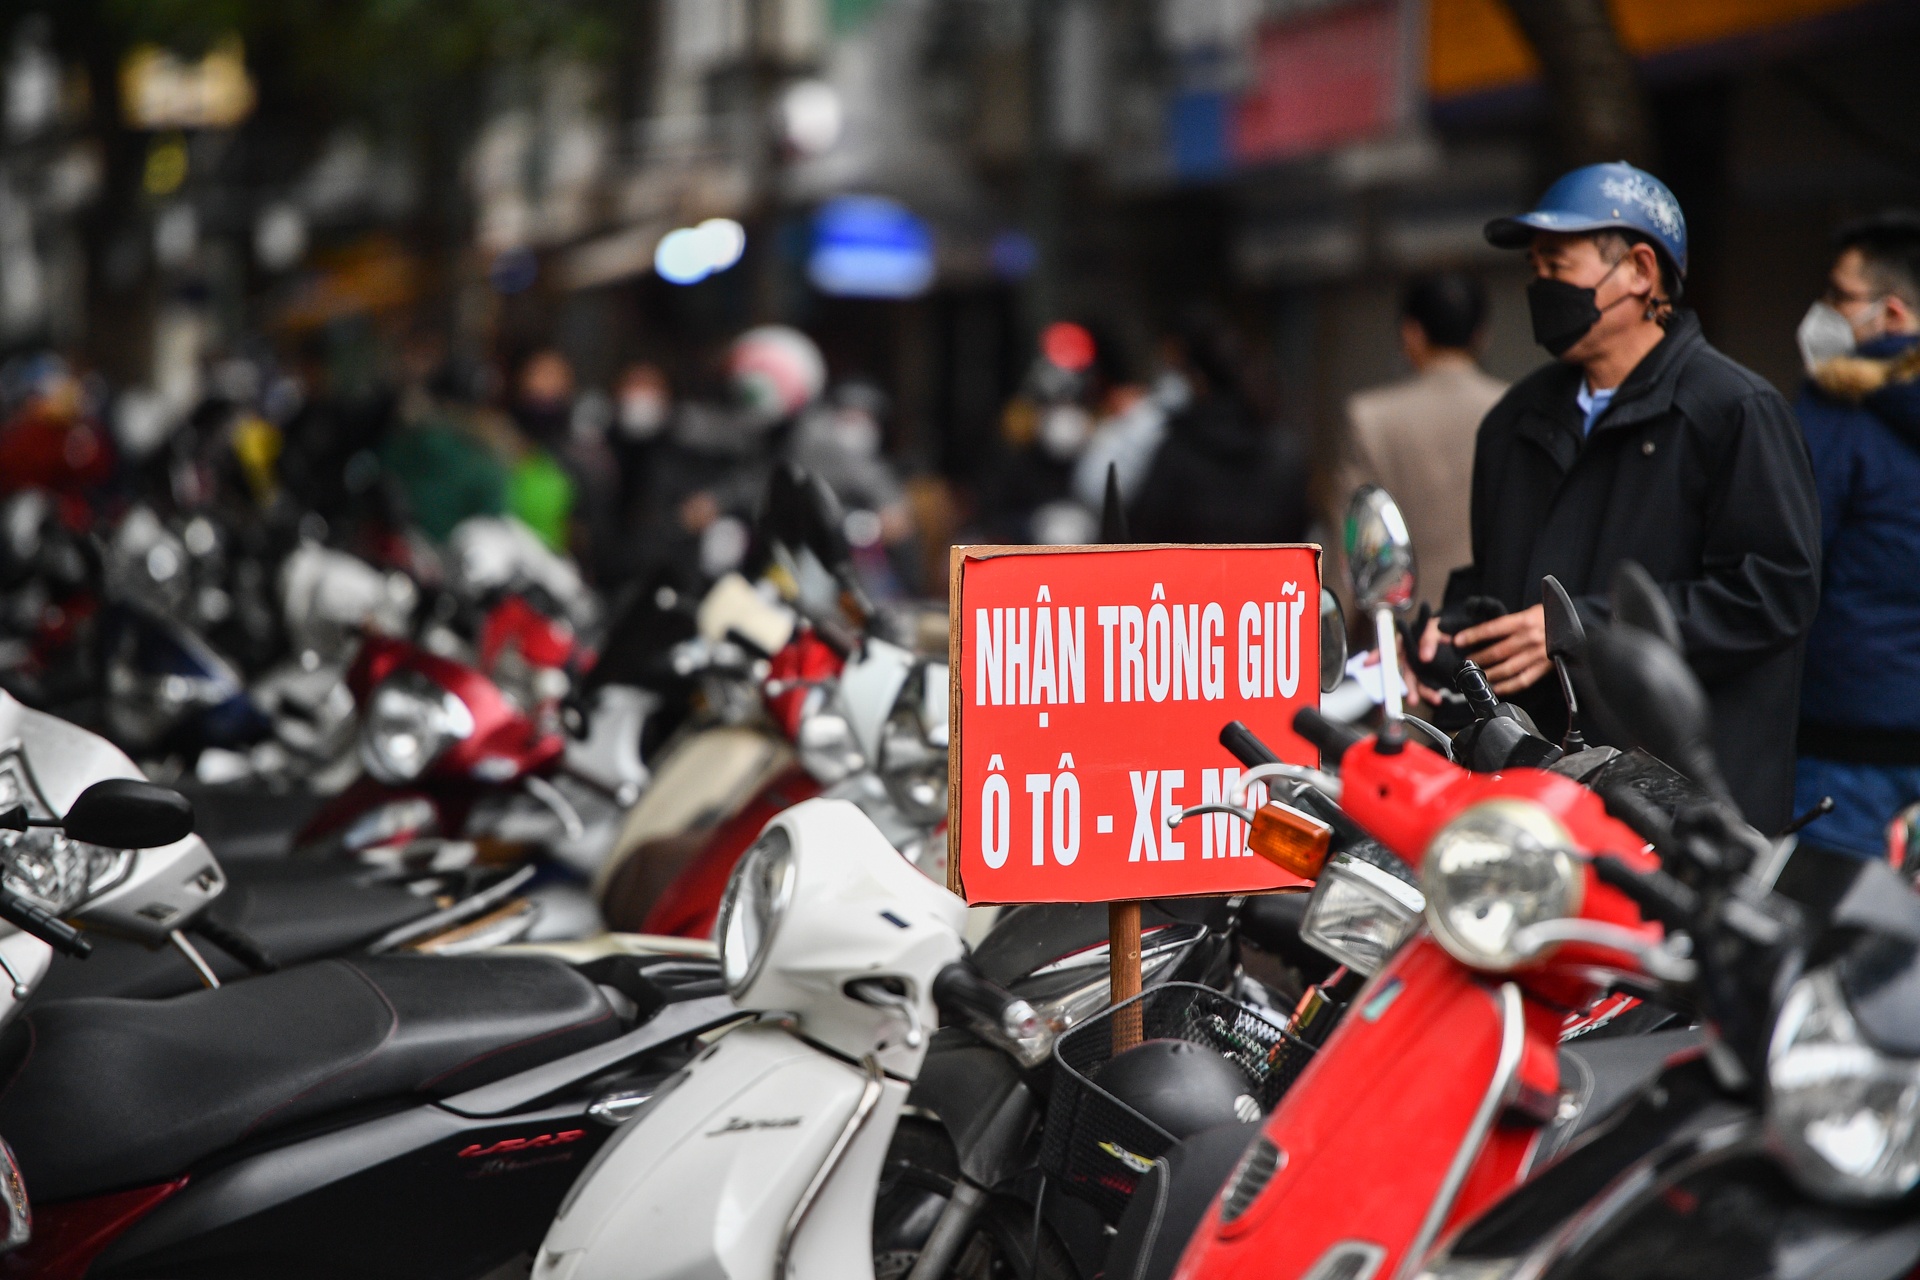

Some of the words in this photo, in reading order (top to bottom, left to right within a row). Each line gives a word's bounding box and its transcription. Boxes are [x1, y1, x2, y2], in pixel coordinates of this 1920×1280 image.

[976, 584, 1085, 728] NHẬN
[1097, 583, 1225, 703] TRÔNG
[1238, 581, 1306, 700] GIỮ
[981, 753, 1011, 870] Ô
[1026, 752, 1081, 867] TÔ
[1097, 815, 1114, 834] -
[1128, 769, 1185, 863] XE
